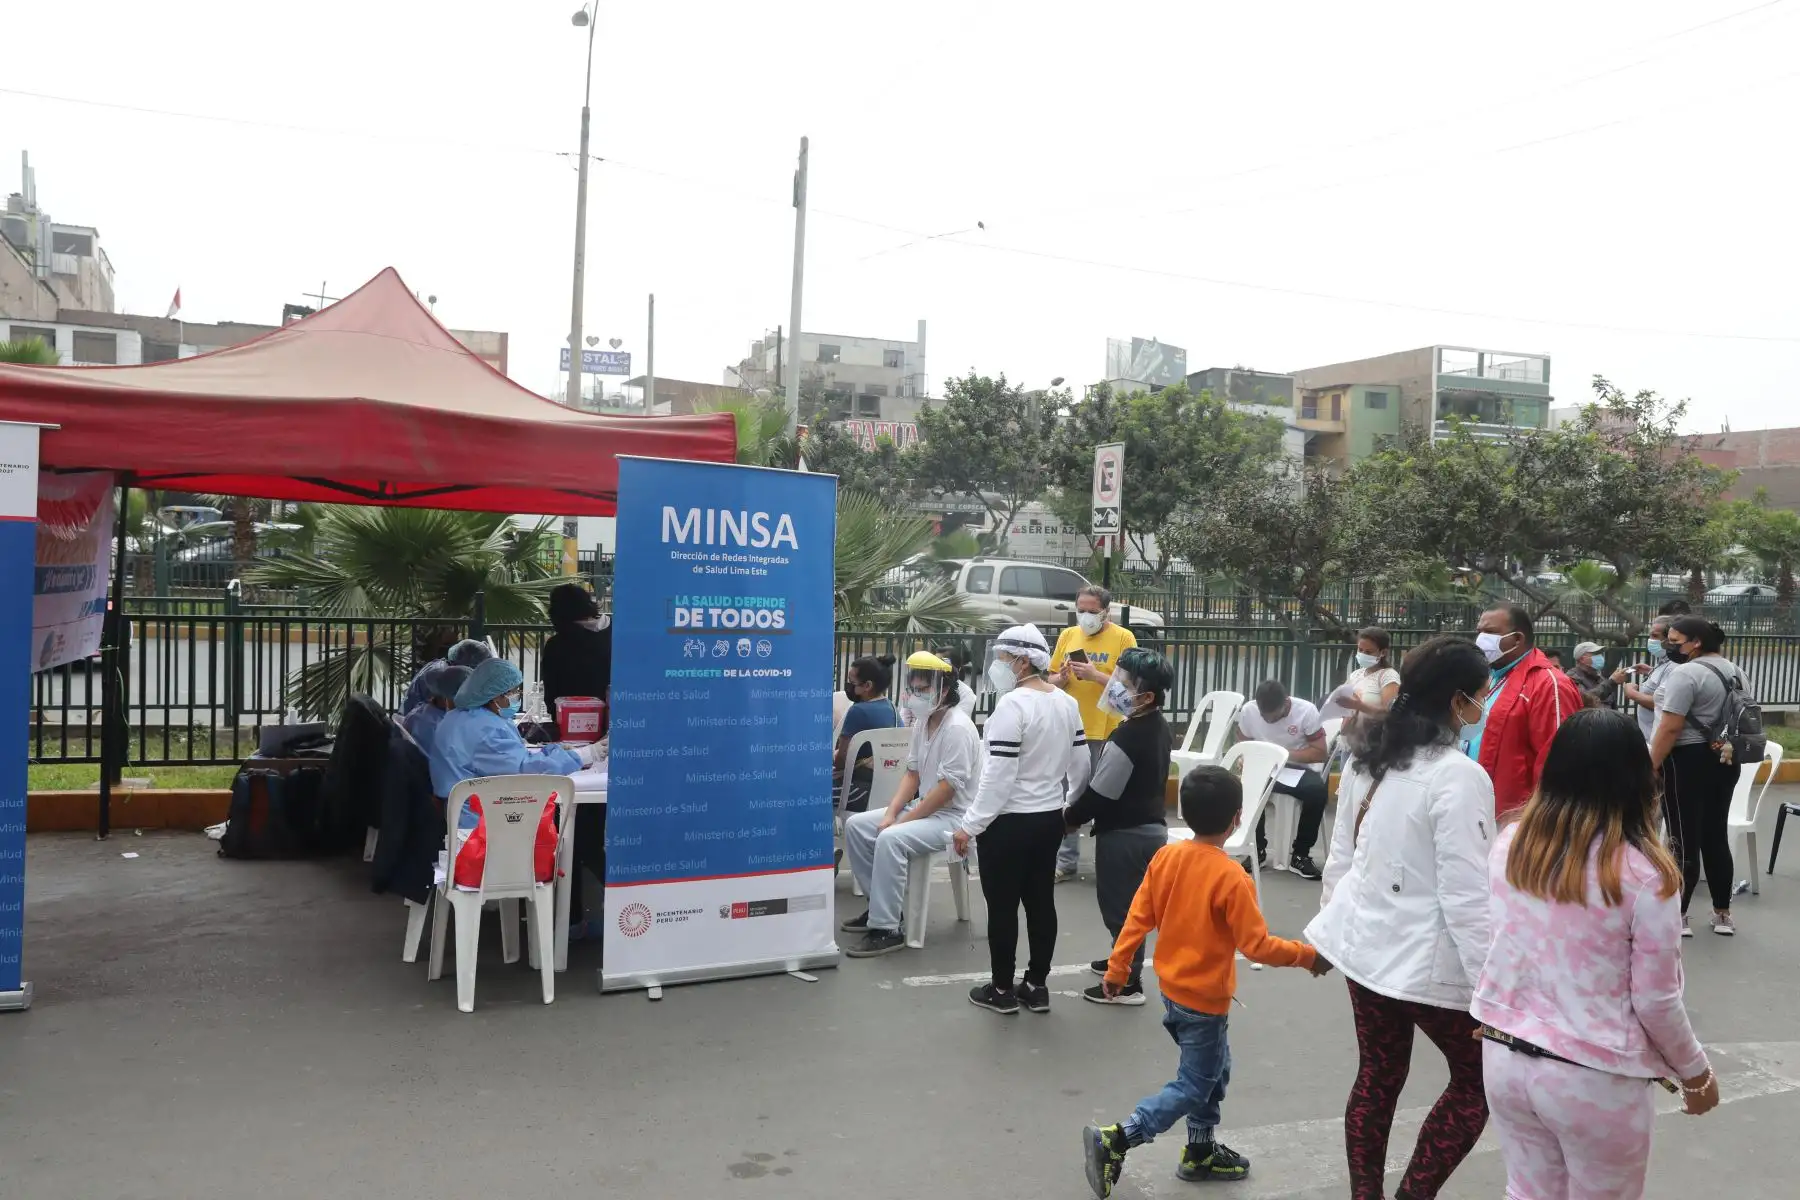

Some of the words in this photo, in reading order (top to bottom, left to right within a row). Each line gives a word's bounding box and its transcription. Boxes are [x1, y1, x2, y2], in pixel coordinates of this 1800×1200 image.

[562, 350, 619, 364] HSTAL
[661, 505, 799, 550] MINSA
[670, 550, 708, 561] Dirección
[710, 552, 720, 561] de
[722, 553, 748, 563] Redes
[749, 554, 789, 566] Integradas
[692, 565, 703, 573] de
[705, 565, 728, 574] Salud
[730, 566, 750, 575] Lima
[751, 567, 768, 576] Este
[674, 594, 690, 606] LA
[692, 595, 732, 608] SALUD
[734, 596, 786, 609] DEPENDE
[674, 607, 704, 628] DE
[708, 608, 786, 629] TODOS
[723, 669, 737, 678] DE
[738, 669, 750, 678] LA
[752, 669, 792, 678] COVID-19
[614, 689, 666, 701] Ministerio
[668, 689, 680, 700] de
[683, 689, 710, 700] Salud
[751, 688, 797, 699] Ministerio
[797, 689, 808, 698] de
[617, 717, 646, 729] Salud
[687, 716, 738, 727] Ministerio
[740, 715, 751, 726] de
[753, 714, 778, 725] Salud
[612, 746, 664, 759] Ministerio
[666, 746, 679, 757] de
[682, 744, 710, 756] Salud
[750, 743, 796, 753] Ministerio
[797, 742, 808, 751] de
[615, 775, 644, 786] Salud
[685, 771, 736, 783] Ministerio
[739, 770, 751, 780] de
[752, 769, 777, 780] Salud
[749, 799, 795, 809] Ministerio
[797, 796, 808, 806] de
[610, 805, 663, 818] Ministerio
[665, 803, 679, 814] de
[680, 801, 708, 813] Salud
[684, 829, 735, 841] Ministerio
[737, 827, 750, 838] de
[751, 825, 777, 836] Salud
[613, 835, 642, 847] Salud
[748, 852, 795, 865] Ministerio
[796, 850, 807, 861] de
[608, 863, 661, 876] Ministerio
[664, 860, 677, 871] de
[679, 857, 707, 870] Salud
[656, 908, 704, 918] BICENTENARIO
